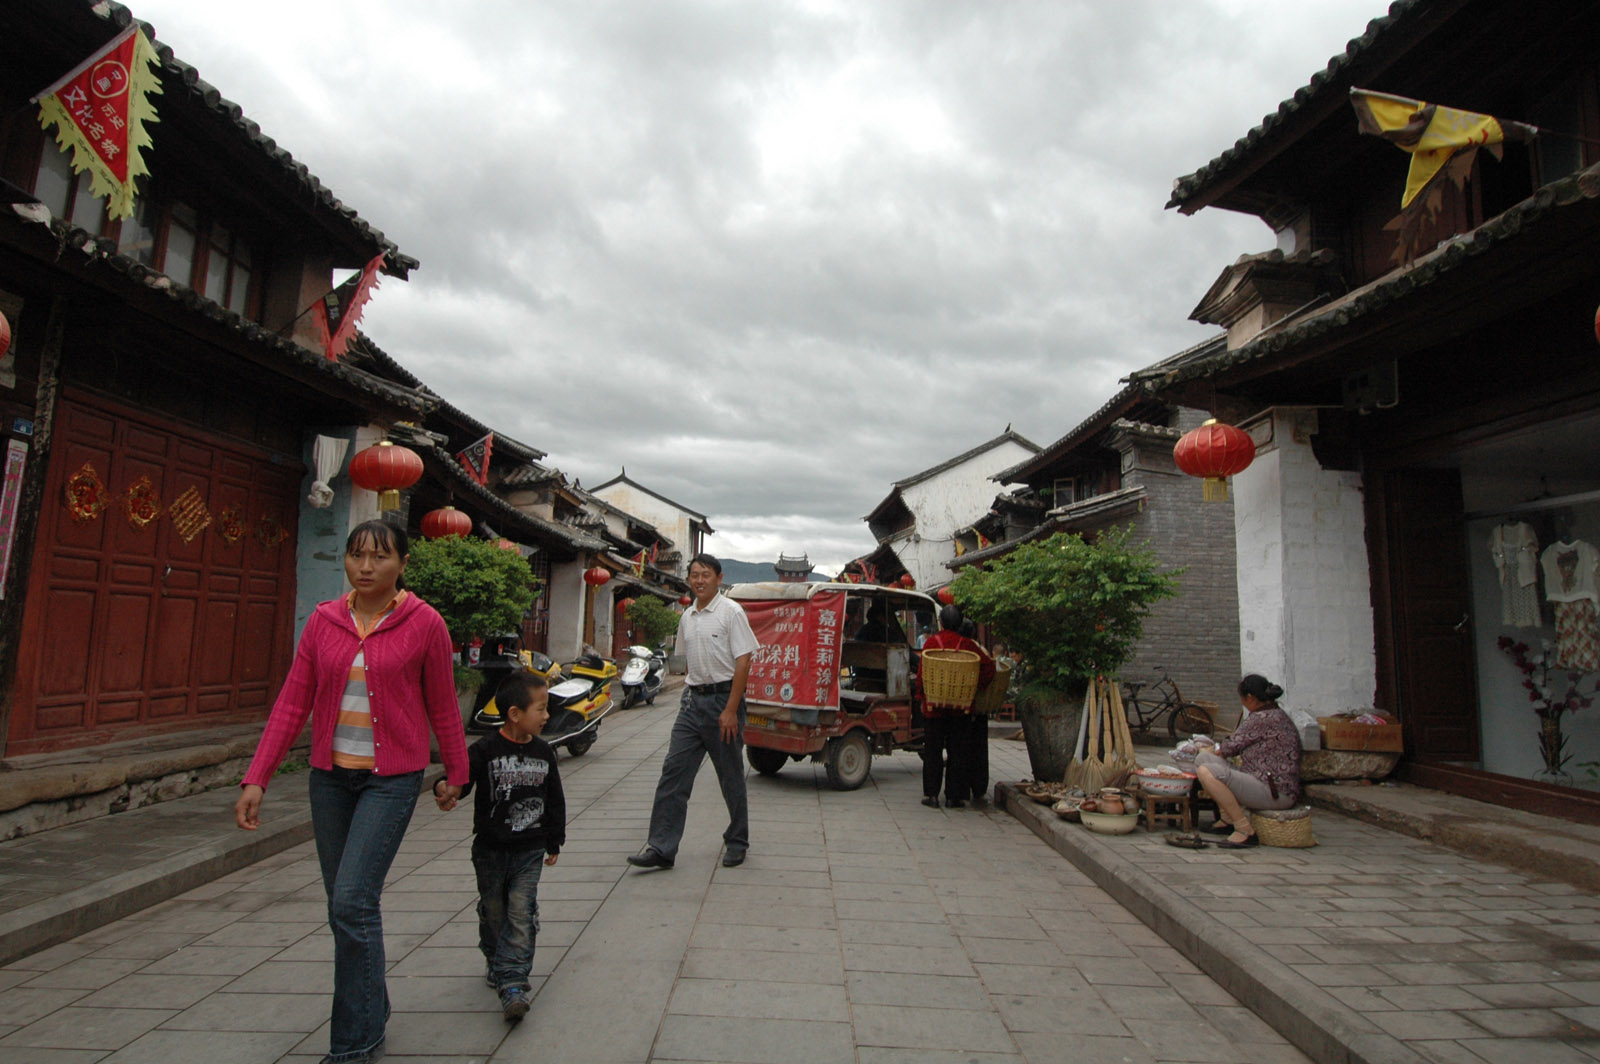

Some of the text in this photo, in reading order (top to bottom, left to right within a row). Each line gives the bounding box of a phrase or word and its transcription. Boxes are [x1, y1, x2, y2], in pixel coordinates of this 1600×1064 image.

[64, 85, 120, 160] 文化名城
[102, 103, 124, 130] 历史
[815, 609, 836, 703] 嘉宝莉涂料
